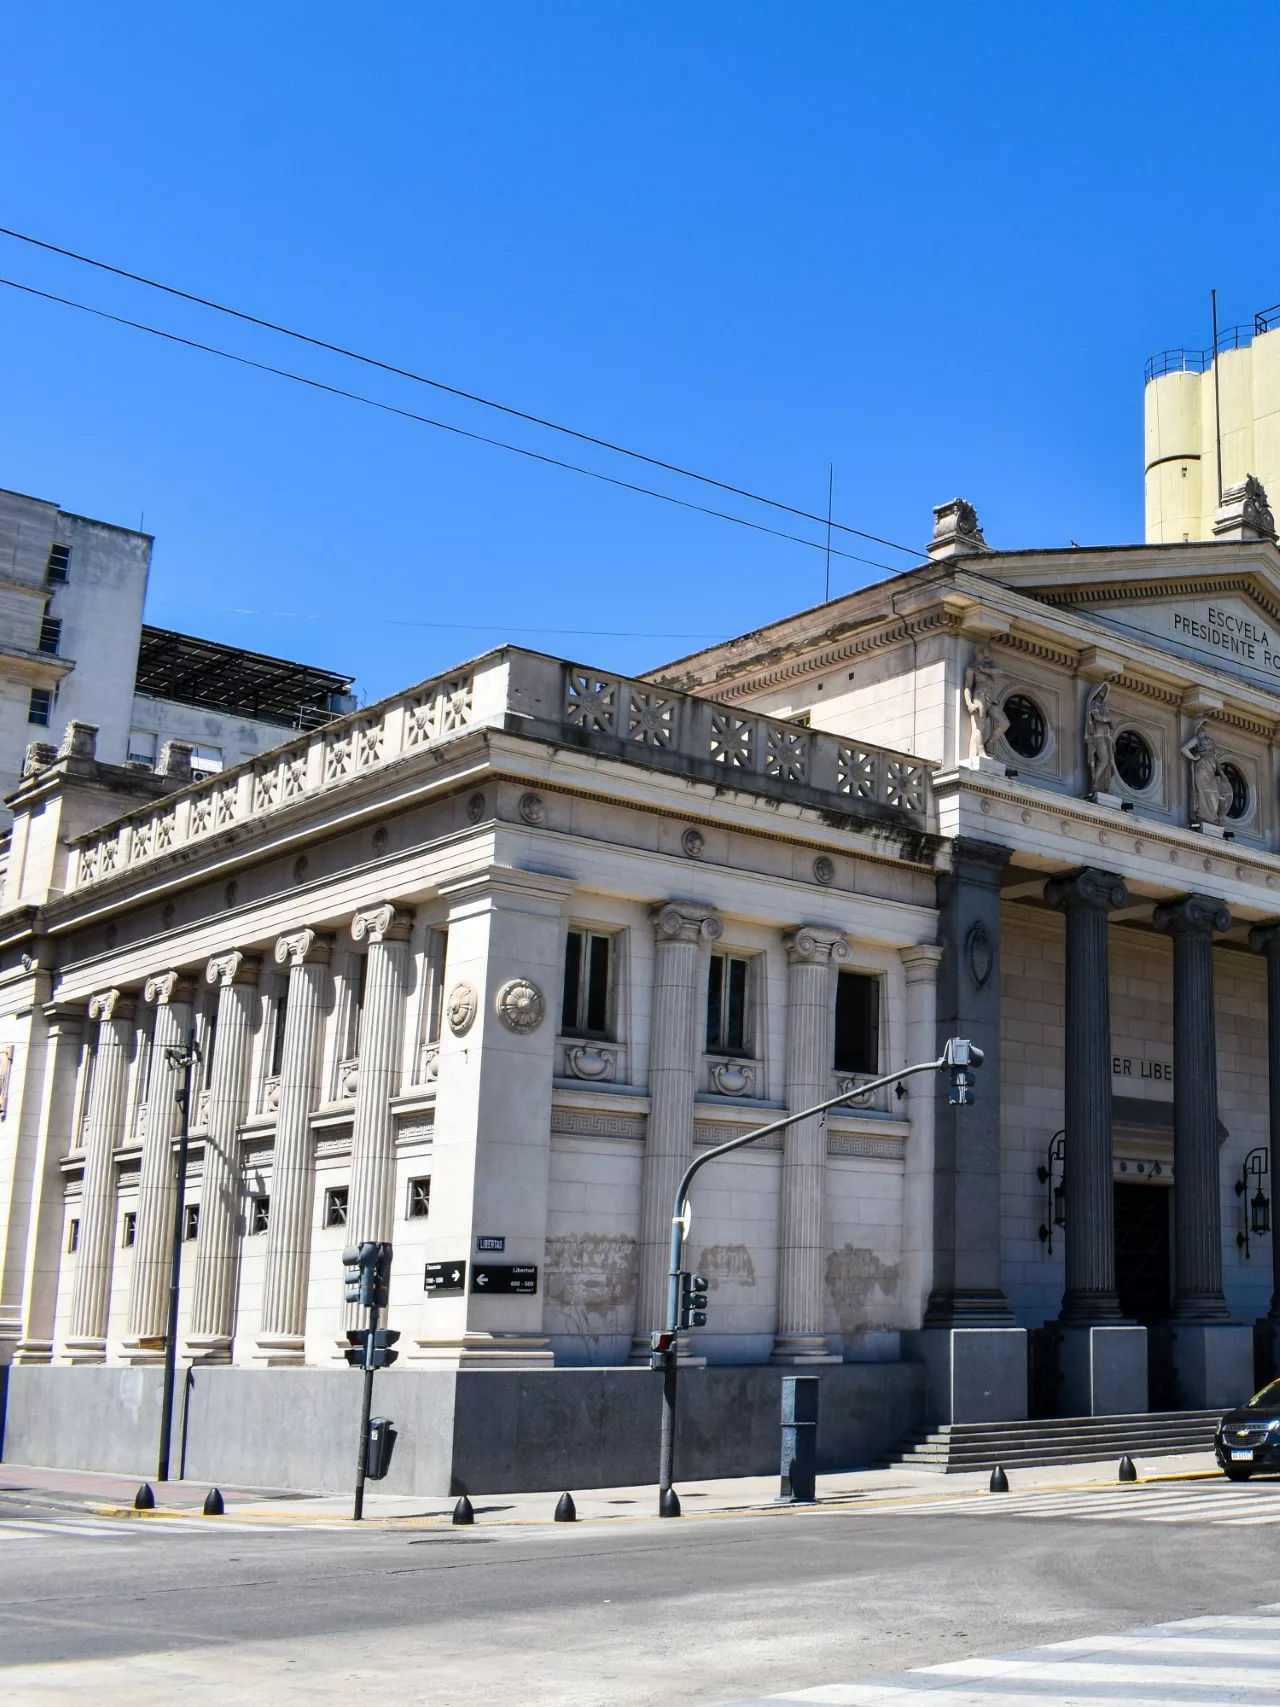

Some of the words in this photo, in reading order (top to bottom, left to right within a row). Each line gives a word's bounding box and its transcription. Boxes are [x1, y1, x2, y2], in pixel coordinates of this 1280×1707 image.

[1174, 614, 1255, 660] PRESIDENTE
[1208, 607, 1269, 646] ESCVELA
[1140, 1061, 1172, 1081] LIBE
[480, 1239, 503, 1249] LIBERTAD
